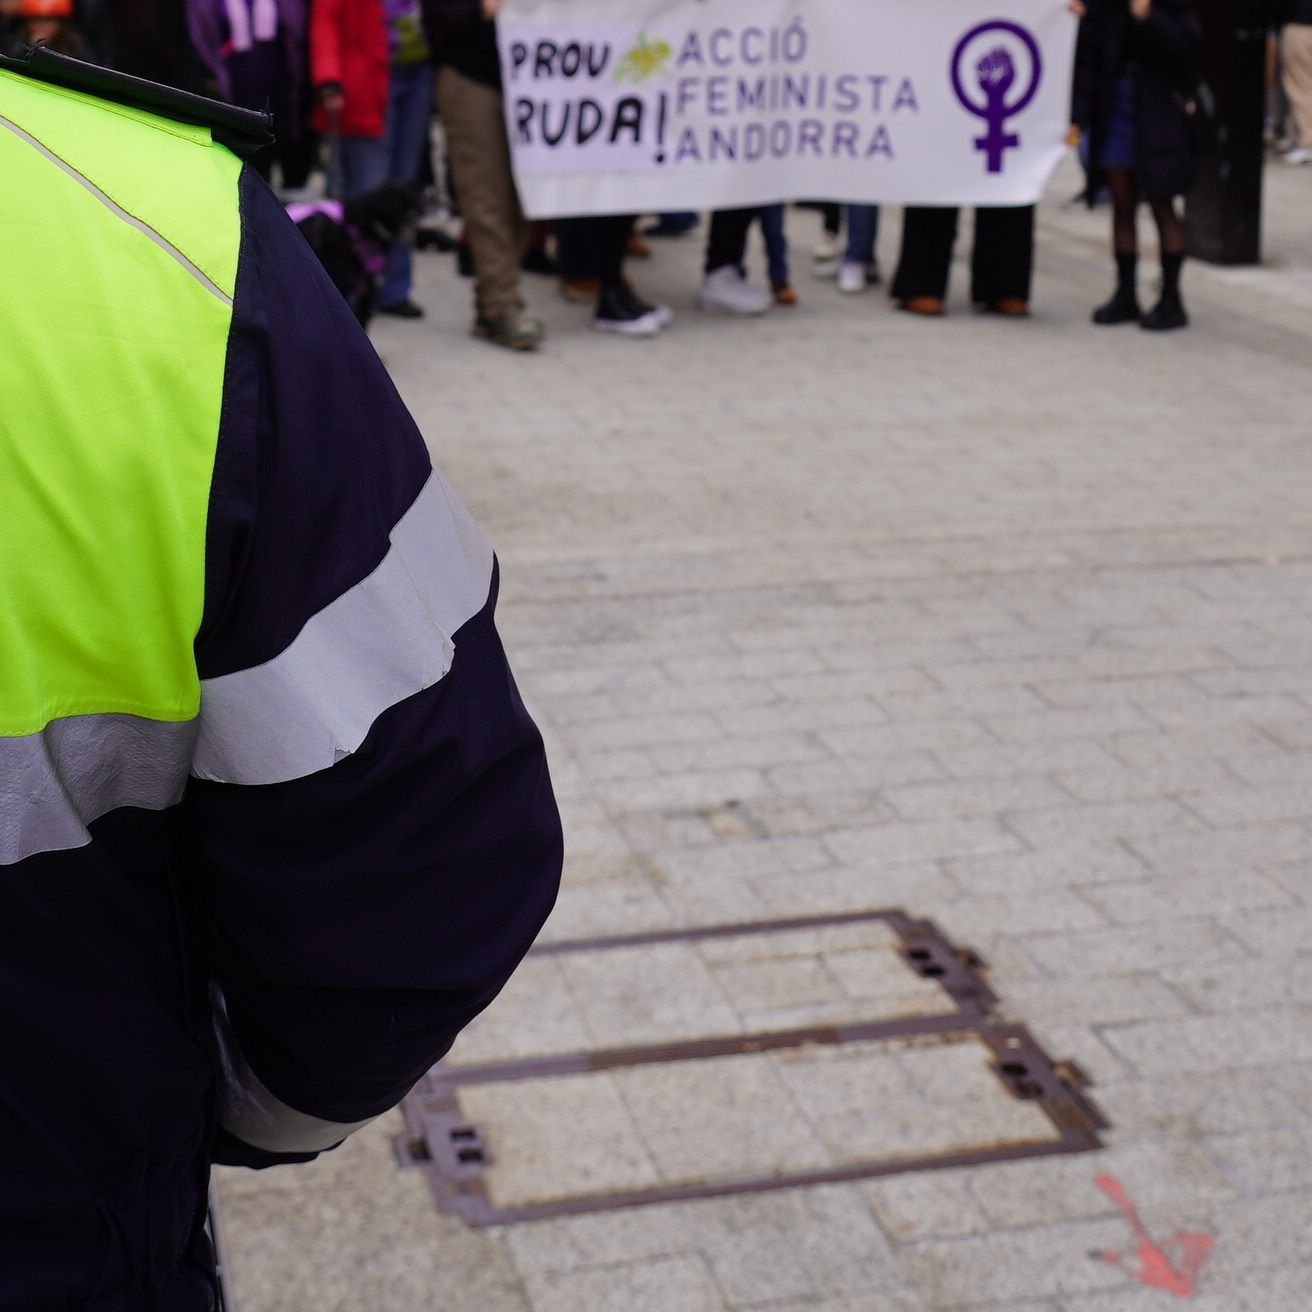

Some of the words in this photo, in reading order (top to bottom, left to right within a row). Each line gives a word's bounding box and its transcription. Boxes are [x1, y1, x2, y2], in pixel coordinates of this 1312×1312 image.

[676, 15, 809, 68] ACCIÓ
[676, 74, 920, 117] FEMINISTA
[515, 90, 668, 164] RUDA!
[675, 119, 896, 163] ANDORRA
